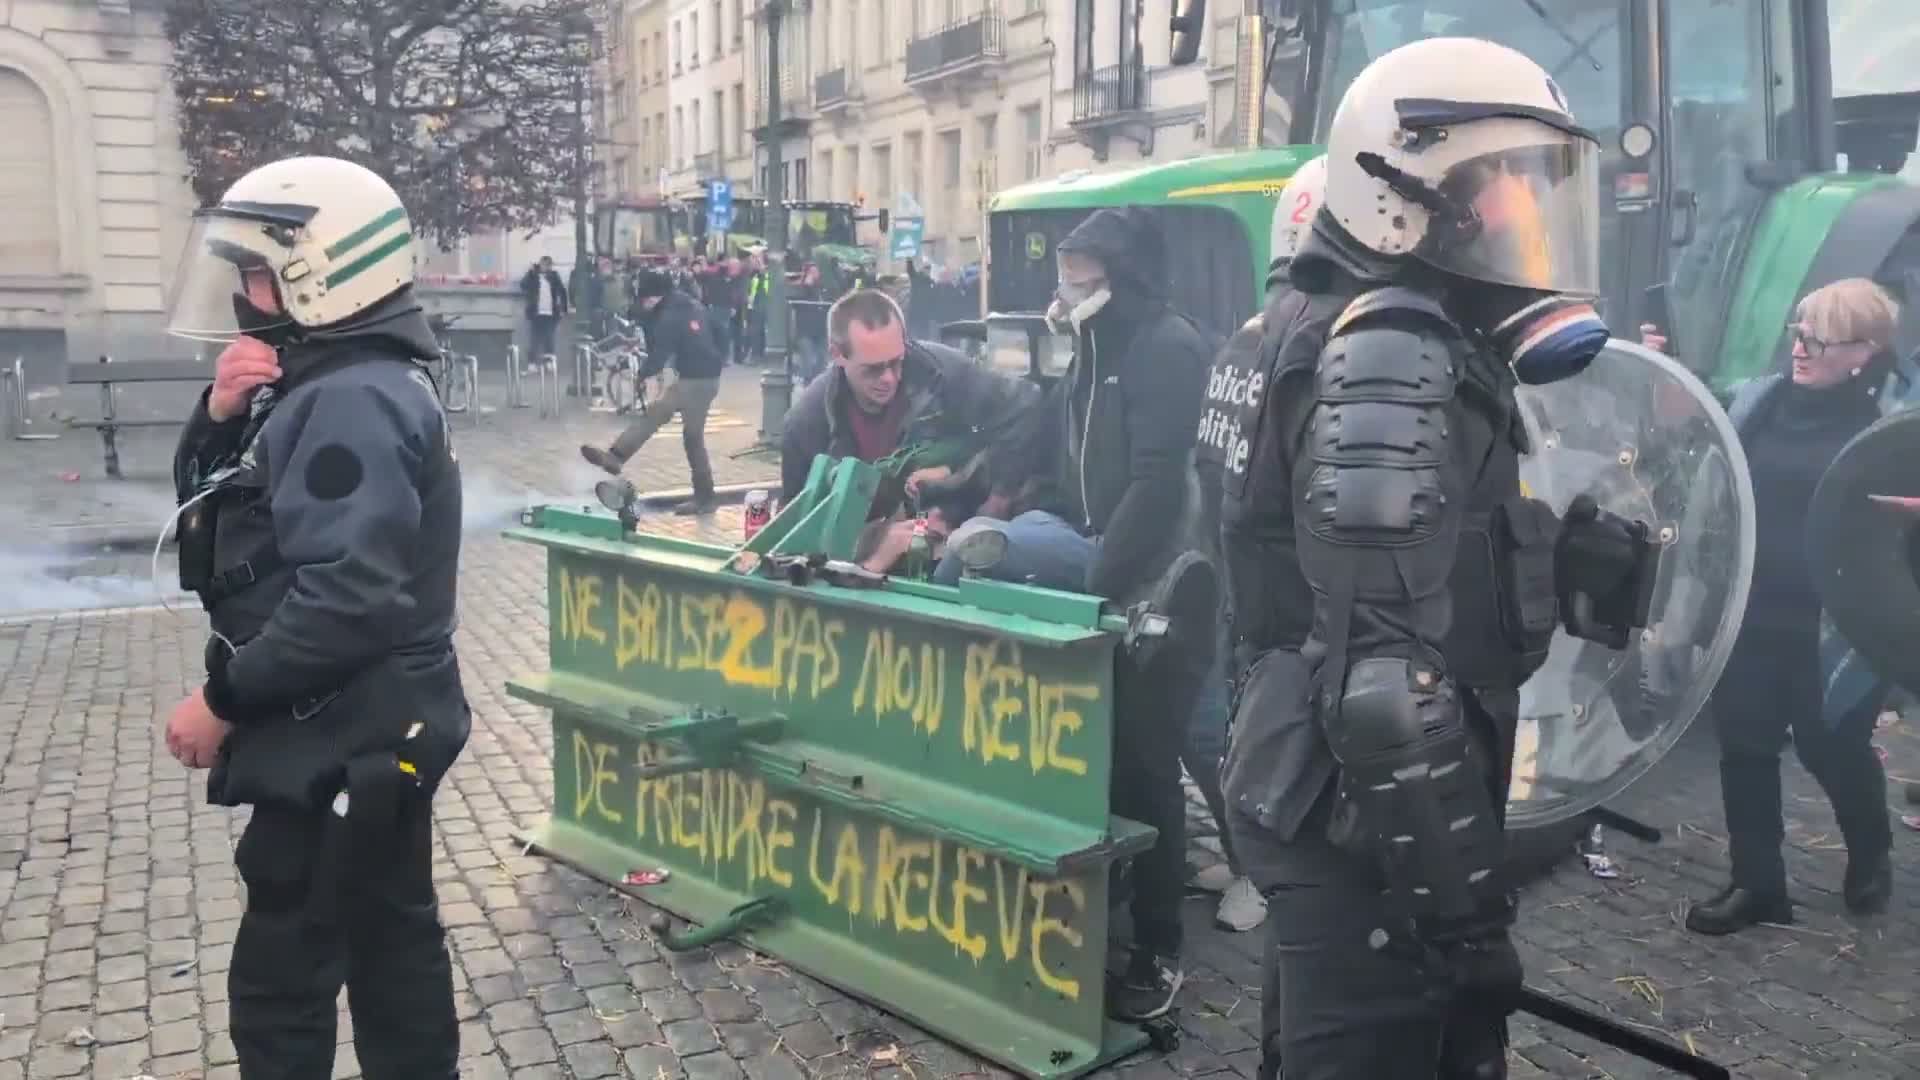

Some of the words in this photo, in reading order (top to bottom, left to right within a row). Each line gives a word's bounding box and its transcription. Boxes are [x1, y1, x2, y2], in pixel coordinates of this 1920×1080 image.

[712, 182, 727, 201] P
[1292, 191, 1312, 224] 2
[1204, 365, 1264, 407] olice
[1197, 408, 1250, 473] olitie
[560, 567, 606, 646] NE
[772, 600, 845, 698] PAS
[573, 730, 623, 824] DE
[635, 742, 798, 891] PRENDRE
[809, 807, 865, 916] LA
